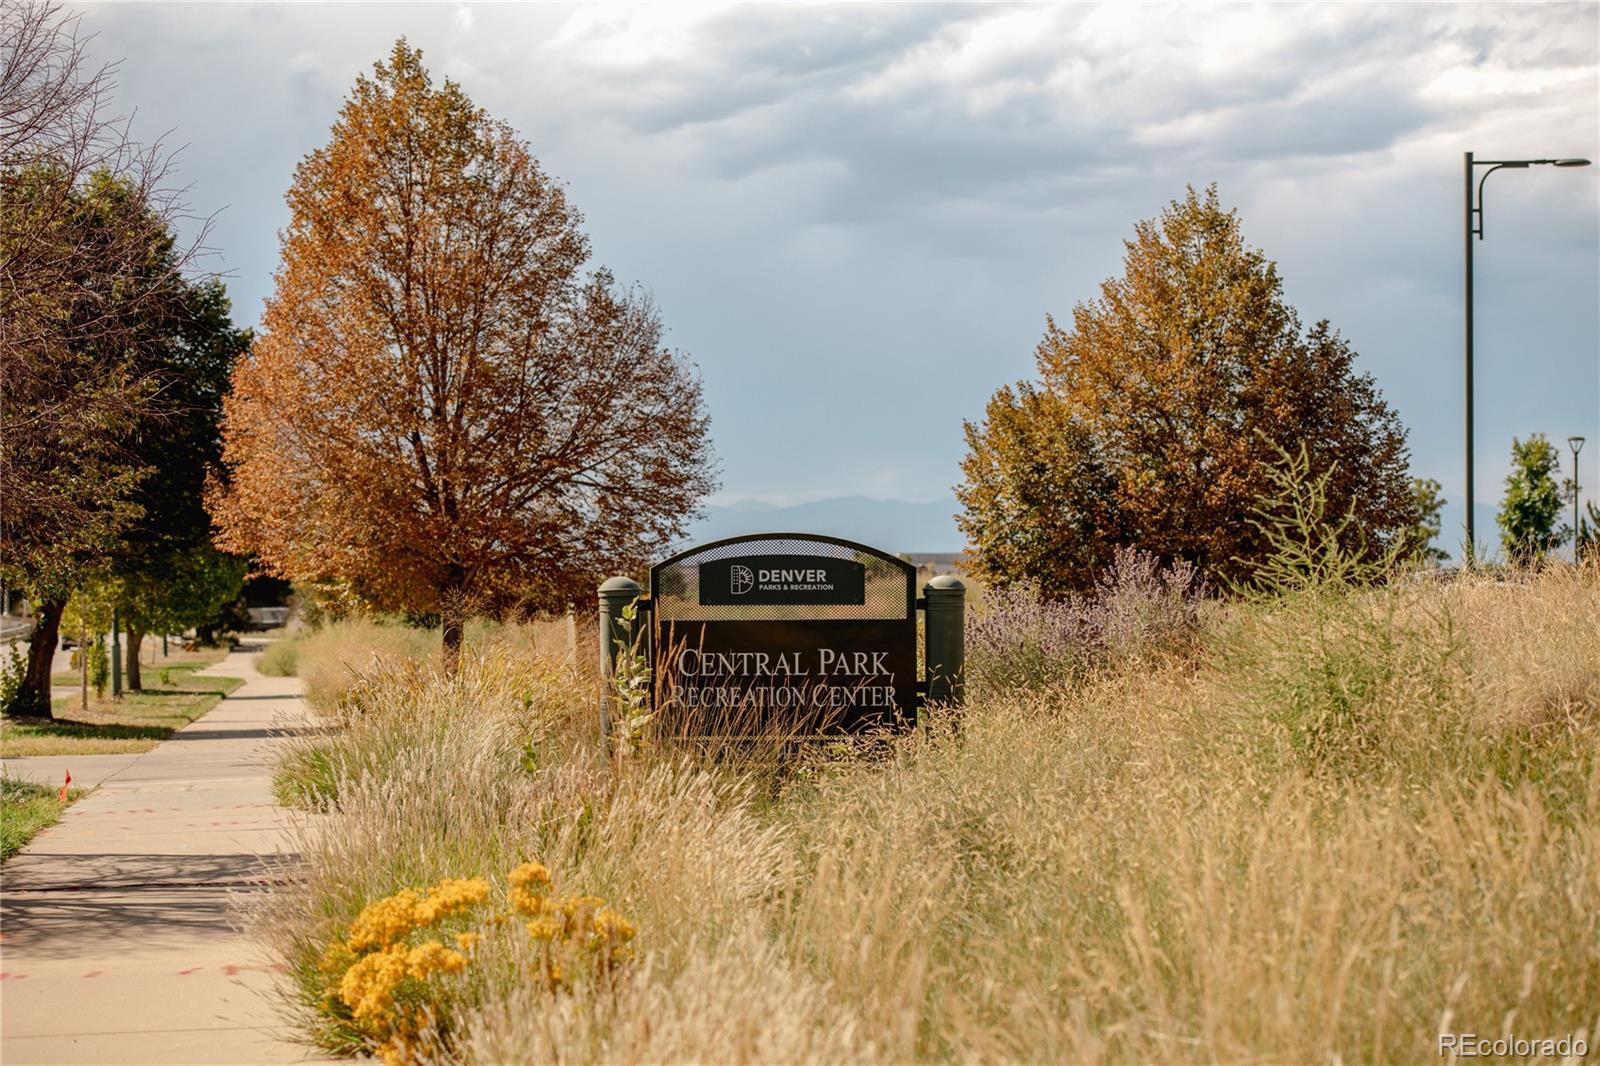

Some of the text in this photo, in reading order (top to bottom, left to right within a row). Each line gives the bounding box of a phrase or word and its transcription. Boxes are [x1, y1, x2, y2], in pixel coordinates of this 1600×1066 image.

[758, 569, 827, 582] DENVER
[678, 648, 892, 677] CENTRAL PARK
[671, 684, 899, 708] RECREATION CENTER
